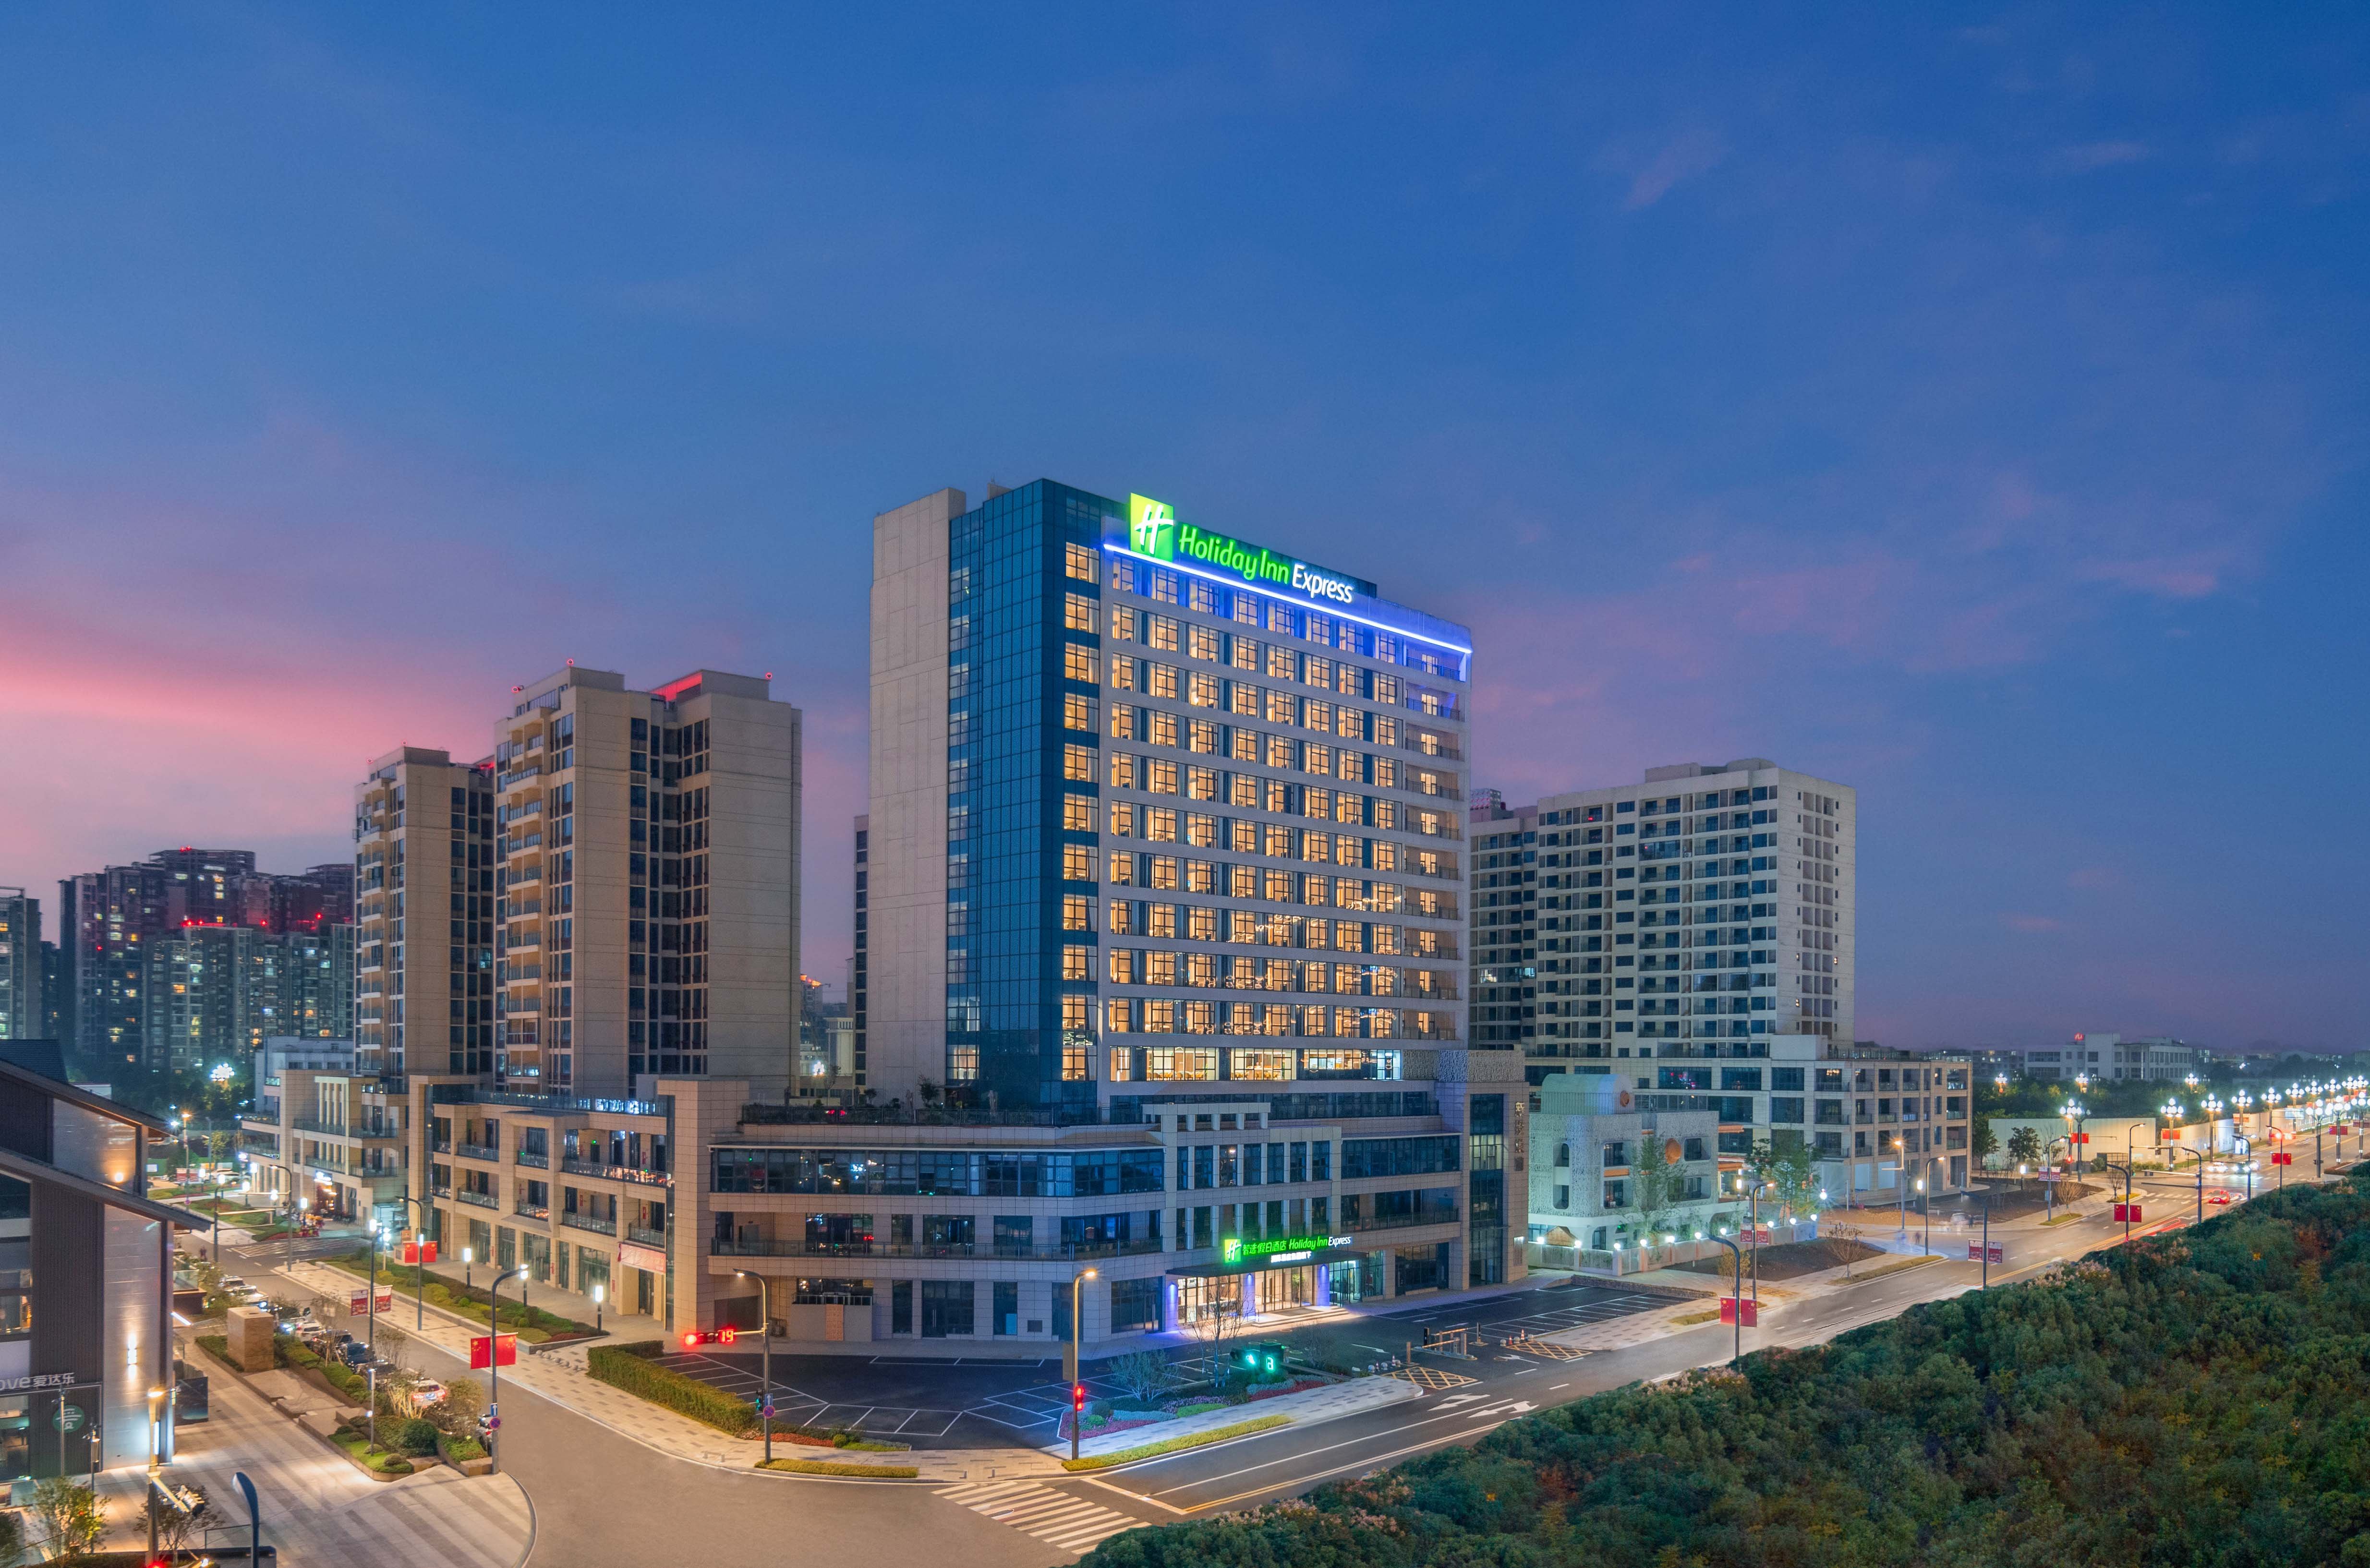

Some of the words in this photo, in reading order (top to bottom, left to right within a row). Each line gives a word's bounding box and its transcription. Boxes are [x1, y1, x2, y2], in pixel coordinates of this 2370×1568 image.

[1179, 524, 1258, 580] Holiday
[1259, 551, 1289, 584] Inn
[1292, 563, 1354, 603] Express
[1242, 1241, 1287, 1255] 智选假日酒店
[1289, 1237, 1316, 1250] Holiday
[1317, 1236, 1328, 1247] Inn
[1328, 1236, 1351, 1248] Express
[722, 1329, 734, 1342] 19
[33, 1373, 75, 1387] 爱达乐
